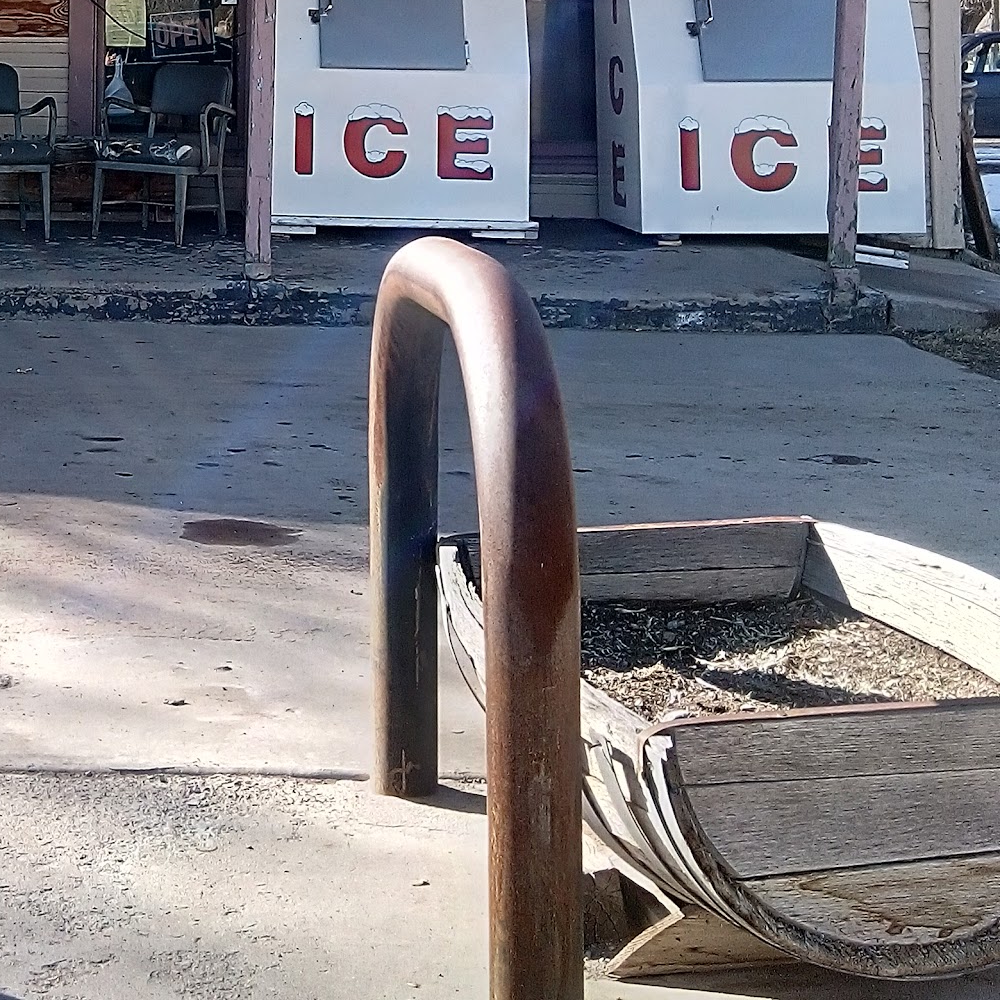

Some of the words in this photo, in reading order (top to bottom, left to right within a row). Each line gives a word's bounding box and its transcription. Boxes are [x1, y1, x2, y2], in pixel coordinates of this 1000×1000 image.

[154, 18, 212, 48] OPEN
[293, 104, 494, 180] ICE
[679, 116, 888, 192] ICE
